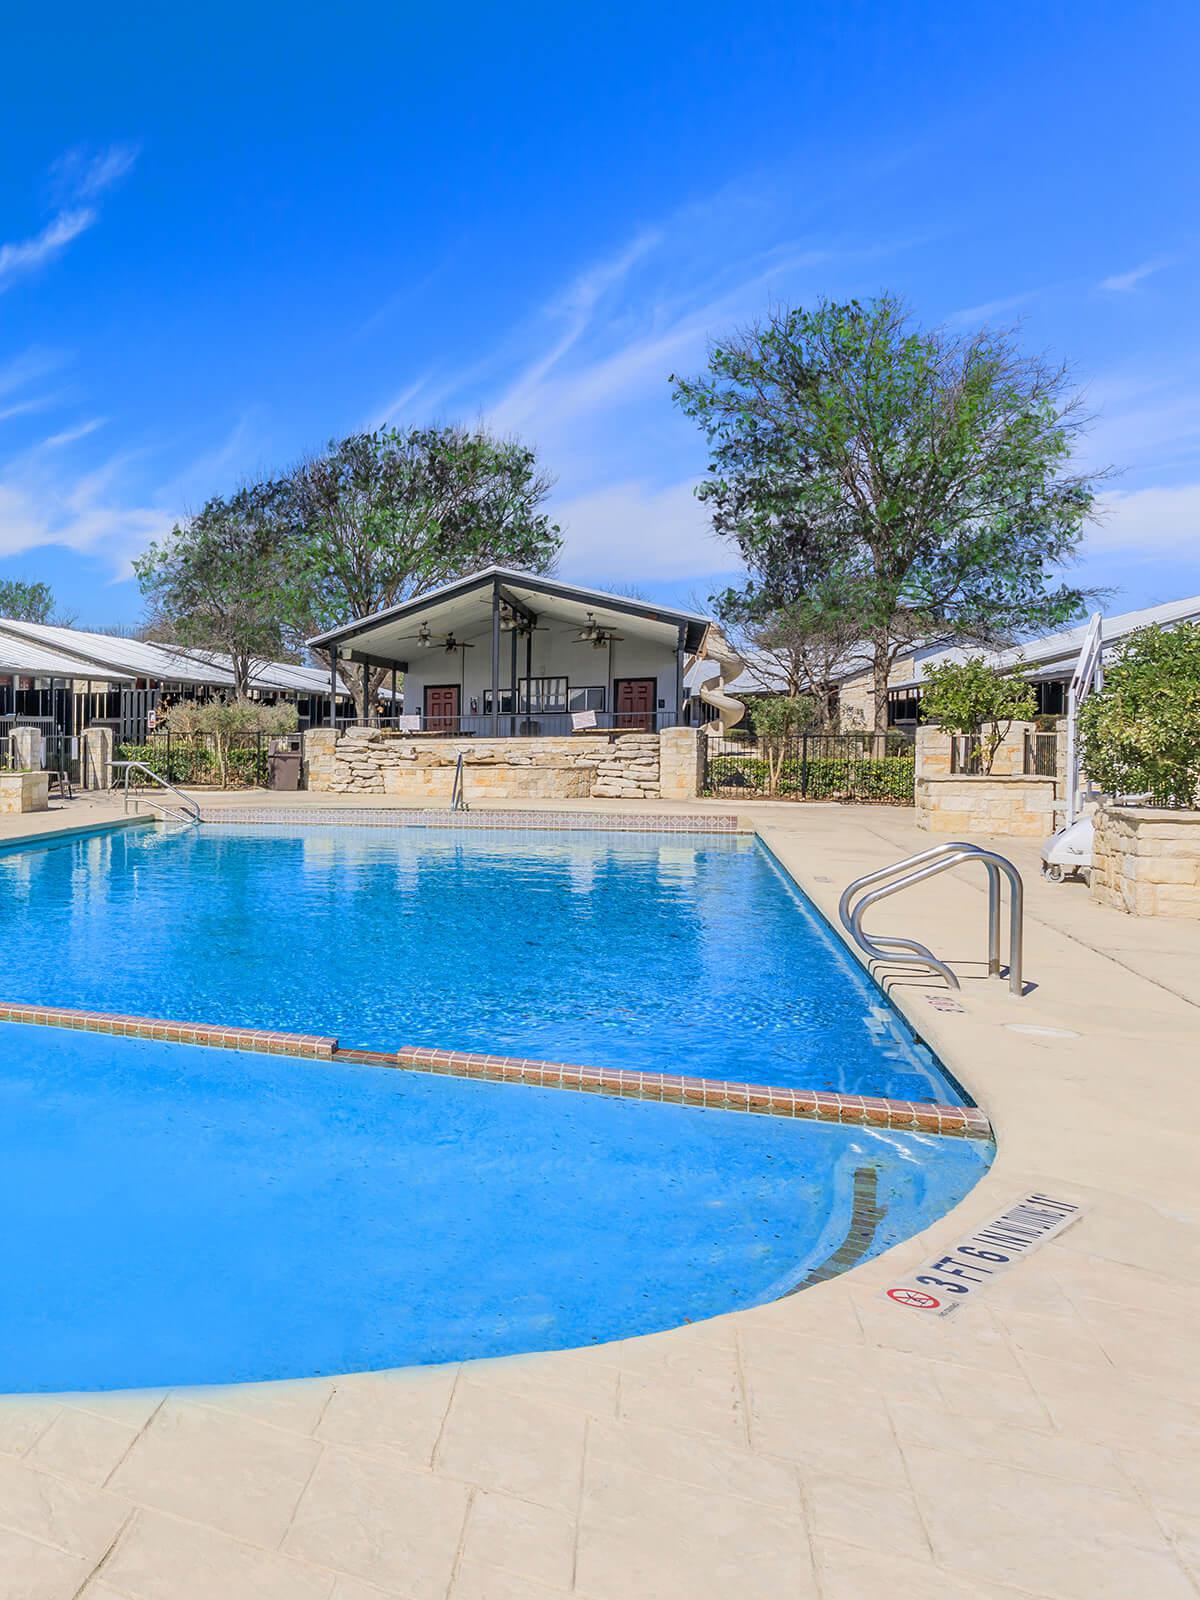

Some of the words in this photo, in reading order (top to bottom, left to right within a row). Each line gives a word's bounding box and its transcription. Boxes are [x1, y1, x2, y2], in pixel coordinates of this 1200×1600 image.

[972, 1232, 1033, 1252] IN
[957, 1245, 1010, 1263] 6
[930, 1256, 994, 1283] FT
[915, 1275, 969, 1294] 3
